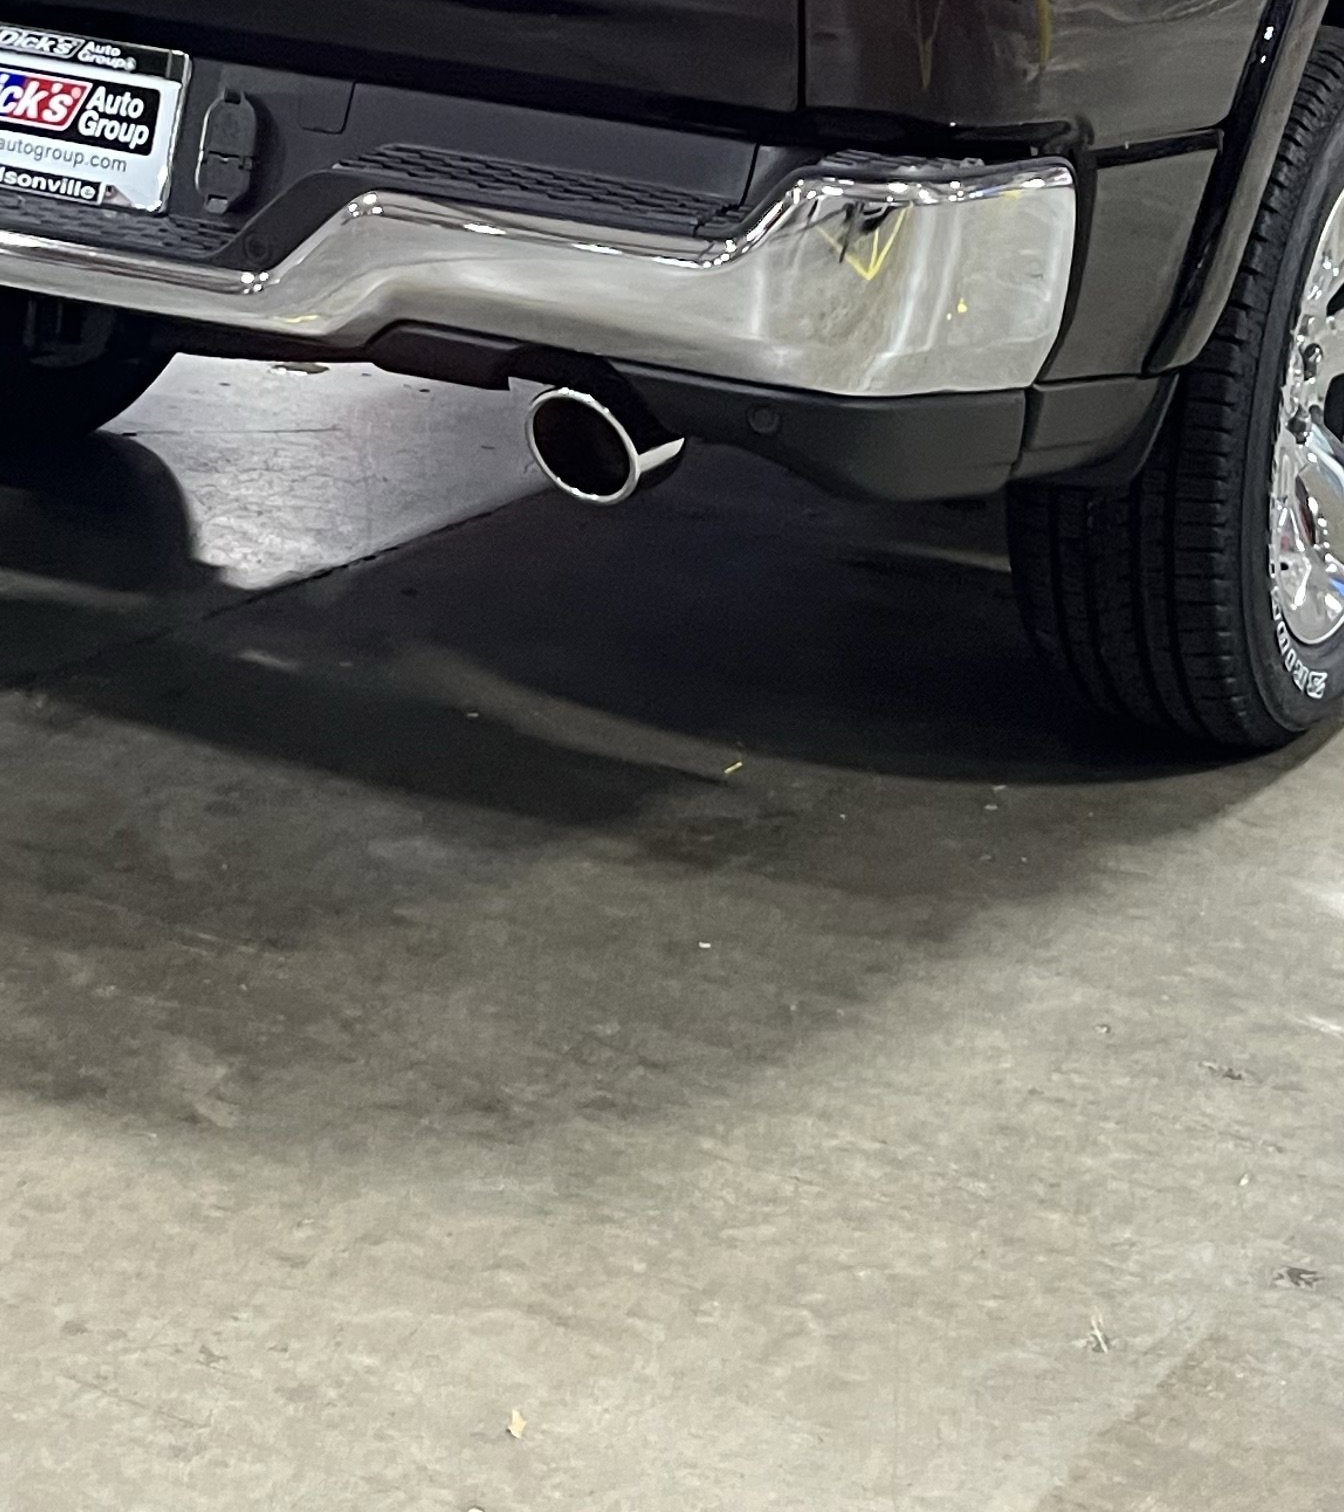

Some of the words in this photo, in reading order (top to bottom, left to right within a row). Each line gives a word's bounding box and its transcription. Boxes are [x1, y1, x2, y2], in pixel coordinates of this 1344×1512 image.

[77, 49, 128, 70] Group
[83, 41, 121, 57] Auto
[85, 86, 144, 120] Auto
[77, 109, 150, 150] Group
